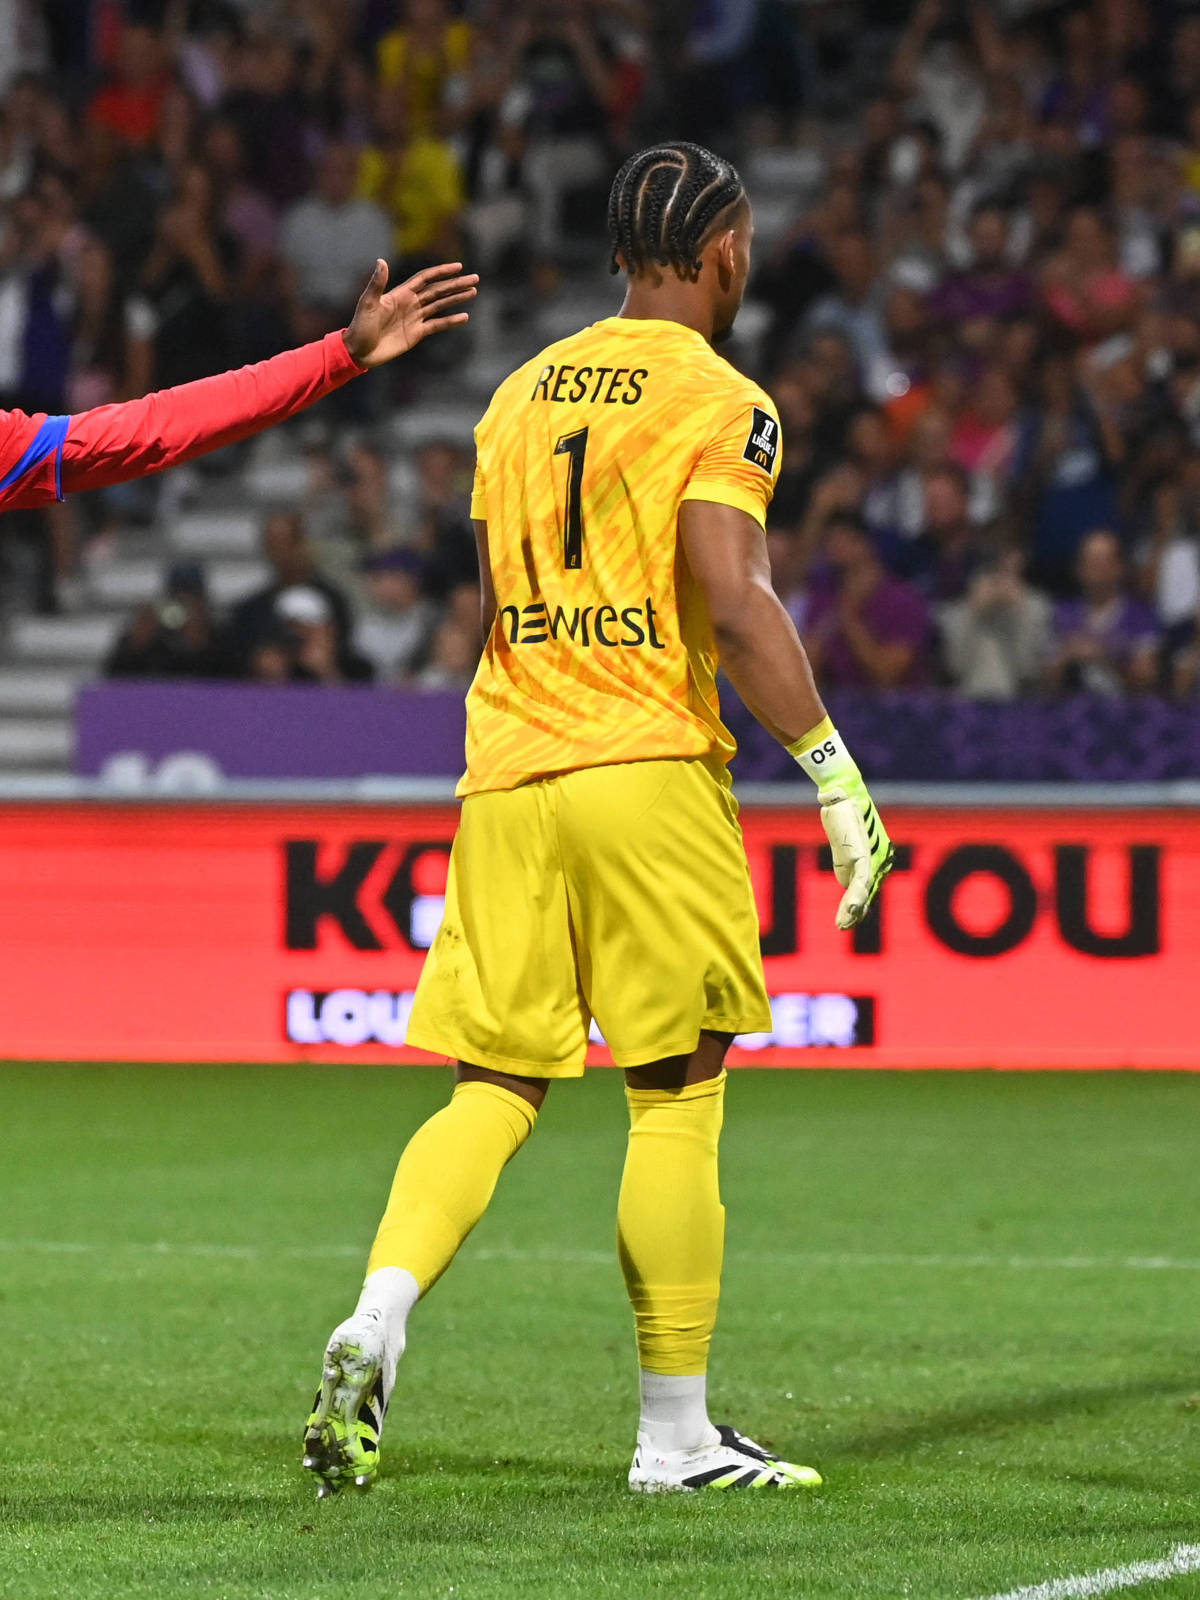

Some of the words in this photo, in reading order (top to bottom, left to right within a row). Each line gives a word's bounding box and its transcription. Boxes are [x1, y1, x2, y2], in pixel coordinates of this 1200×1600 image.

[530, 364, 649, 406] RESTES
[751, 433, 772, 455] LIGUE
[553, 425, 589, 570] 1
[810, 740, 837, 765] 50
